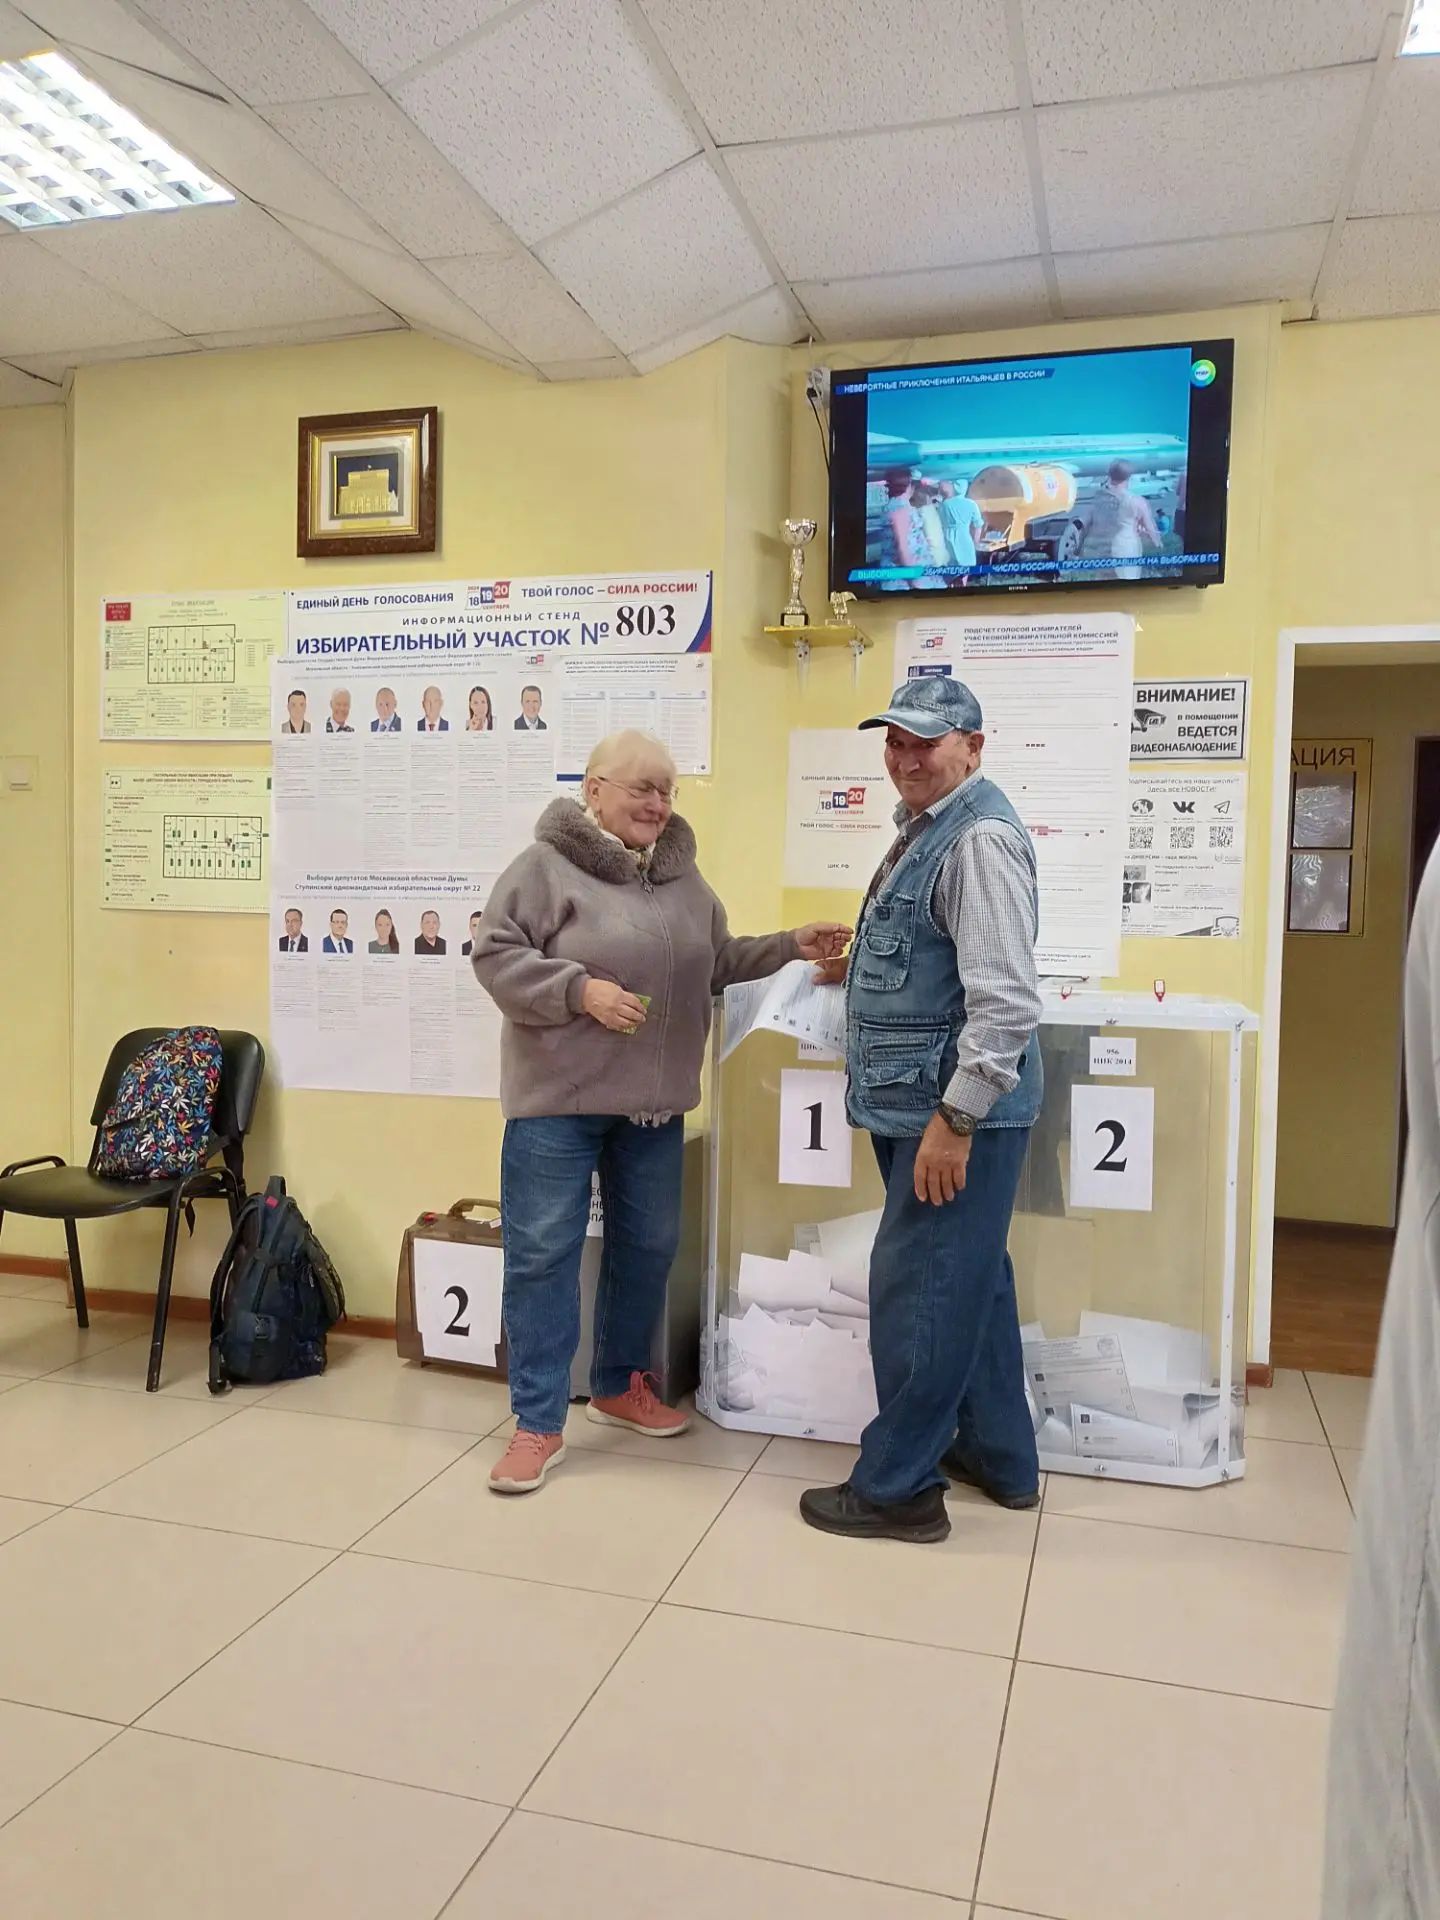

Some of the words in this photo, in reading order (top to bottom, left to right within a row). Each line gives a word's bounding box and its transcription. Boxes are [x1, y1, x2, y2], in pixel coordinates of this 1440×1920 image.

[844, 381, 898, 393] НЕВЕРОЯТНЫЕ
[899, 377, 955, 389] ПРИКЛЮЧЕНИЯ
[956, 373, 1005, 385] ИТАЛЬЯНЦЕВ
[1013, 370, 1046, 380] РОССИИ
[1160, 555, 1200, 565] ВЫБОРАХ
[469, 596, 480, 606] 18
[494, 585, 508, 596] 20
[521, 585, 552, 598] ТВОЙ
[555, 586, 594, 596] ГОЛОС
[607, 584, 640, 595] СИЛА
[643, 583, 698, 595] РОССИИ!
[297, 595, 339, 610] ЕДИНЫЙ
[342, 597, 369, 609] ДЕНЬ
[374, 593, 454, 605] ГОЛОСОВАНИЯ
[402, 611, 532, 626] ИНФОРМАЦИОННЫЙ
[538, 611, 581, 621] СТЕНД
[296, 629, 466, 655] ИЗБИРАТЕЛЬНЫЙ
[473, 628, 571, 648] УЧАСТОК
[581, 622, 610, 645] №
[615, 604, 676, 637] 803
[1136, 688, 1236, 703] ВНИМАНИЕ!
[1177, 726, 1238, 738] ВЕДЕТСЯ
[1131, 742, 1238, 753] ВИДЕОНАБЛЮДЕНИЕ
[821, 801, 832, 810] 18
[849, 791, 863, 801] 20
[803, 1102, 829, 1152] 1
[1093, 1119, 1128, 1173] 2
[443, 1285, 471, 1337] 2
